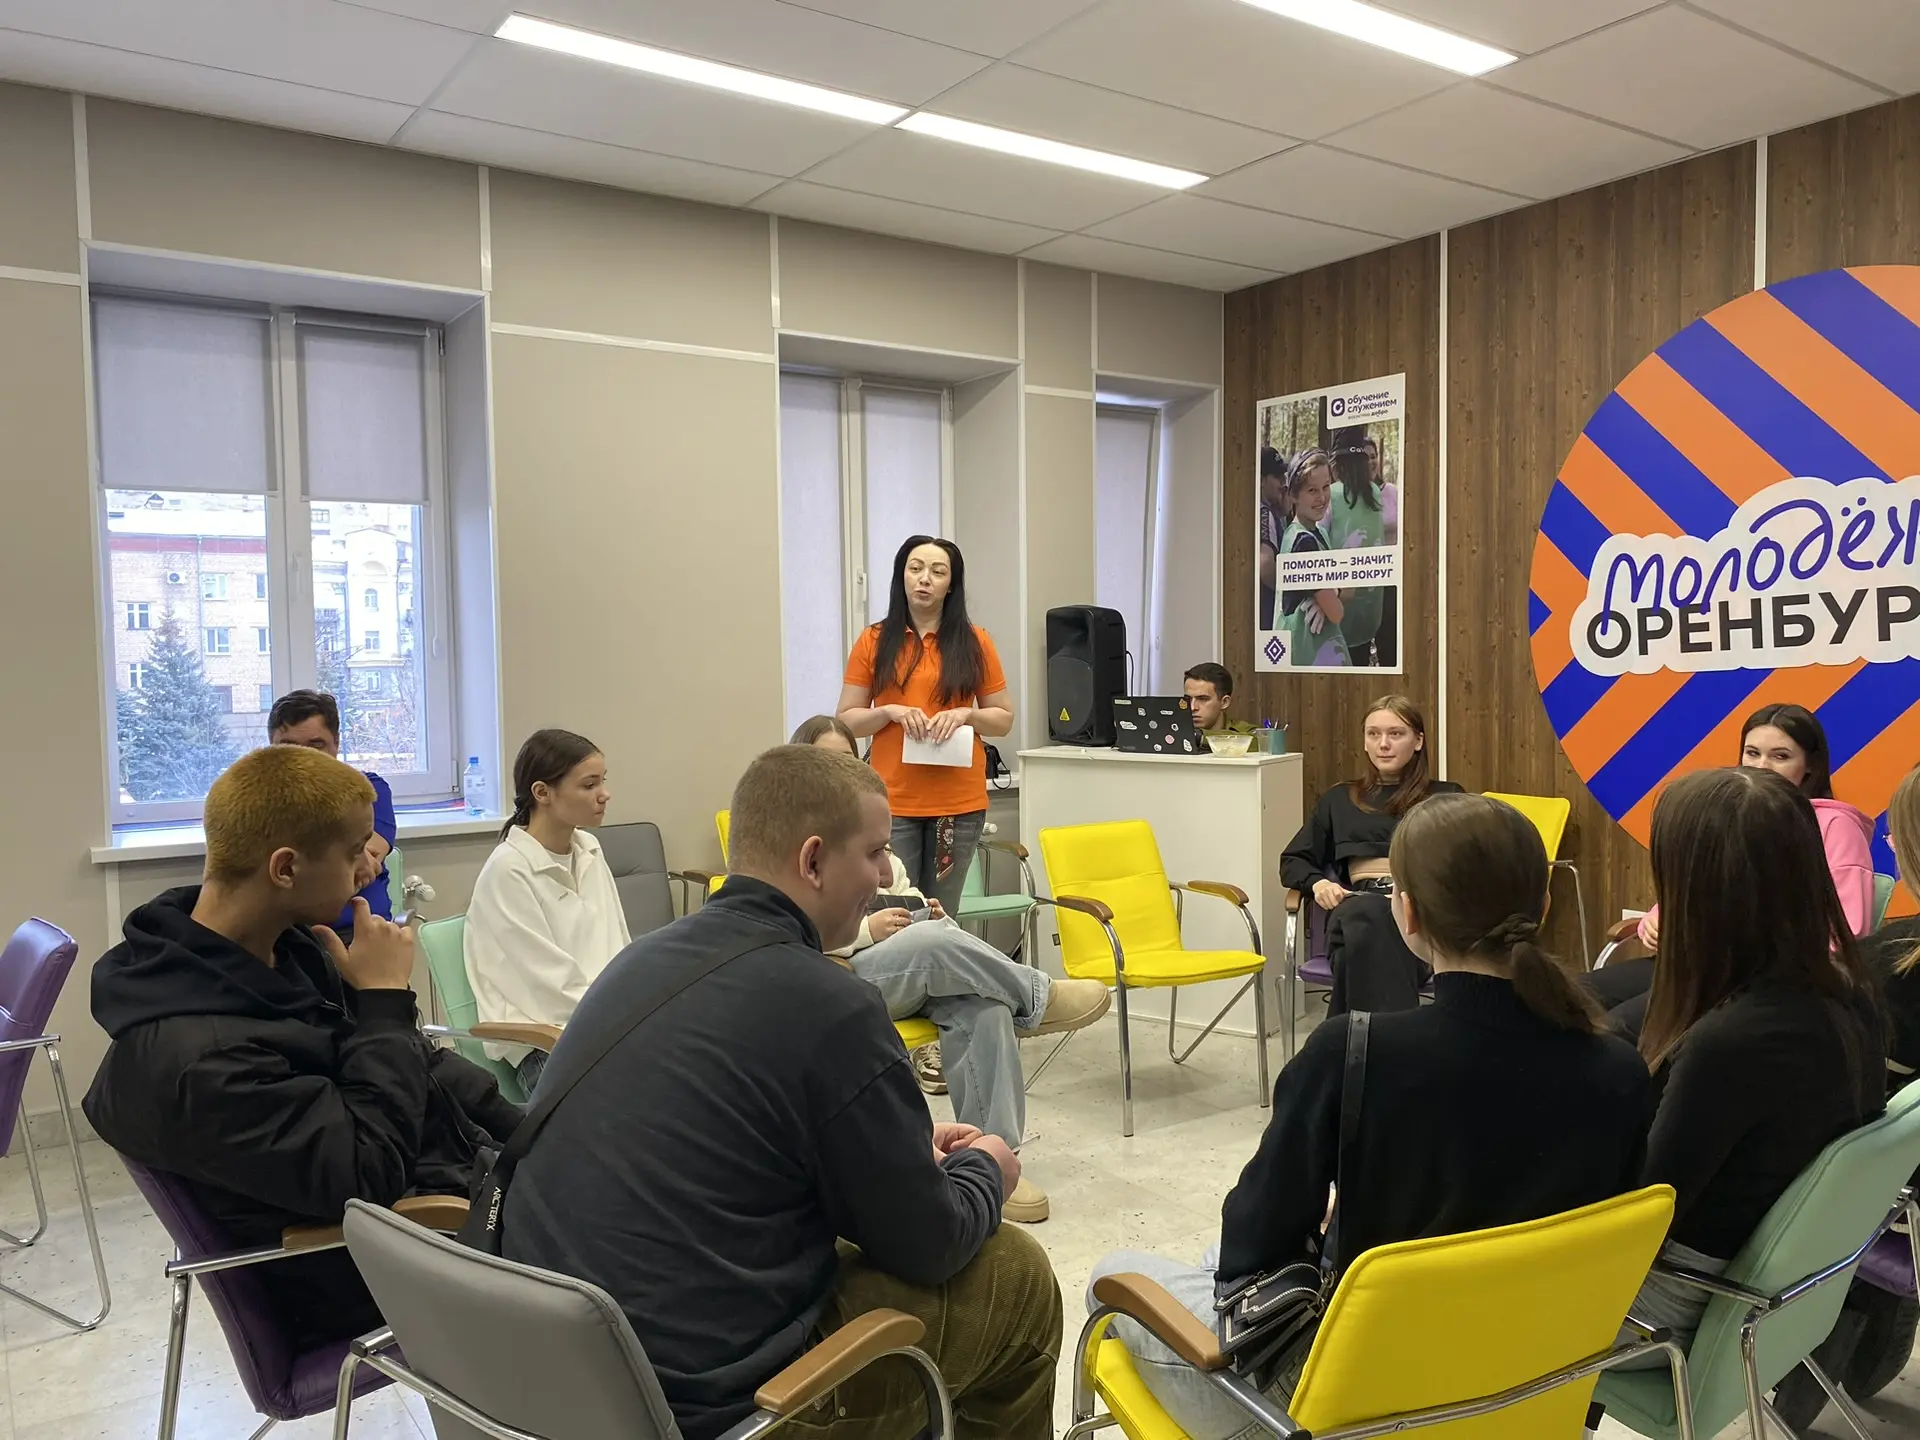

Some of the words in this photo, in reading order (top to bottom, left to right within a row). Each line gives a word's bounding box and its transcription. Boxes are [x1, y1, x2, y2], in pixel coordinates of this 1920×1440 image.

[1347, 391, 1390, 405] обучение
[1347, 399, 1398, 414] служением
[1283, 558, 1337, 570] ПОМОГАТЬ
[1283, 572, 1324, 583] МЕНЯТЬ
[1325, 571, 1349, 581] МИР
[1351, 568, 1393, 580] ВОКРУГ
[1586, 585, 1920, 659] ОРЕНБУР
